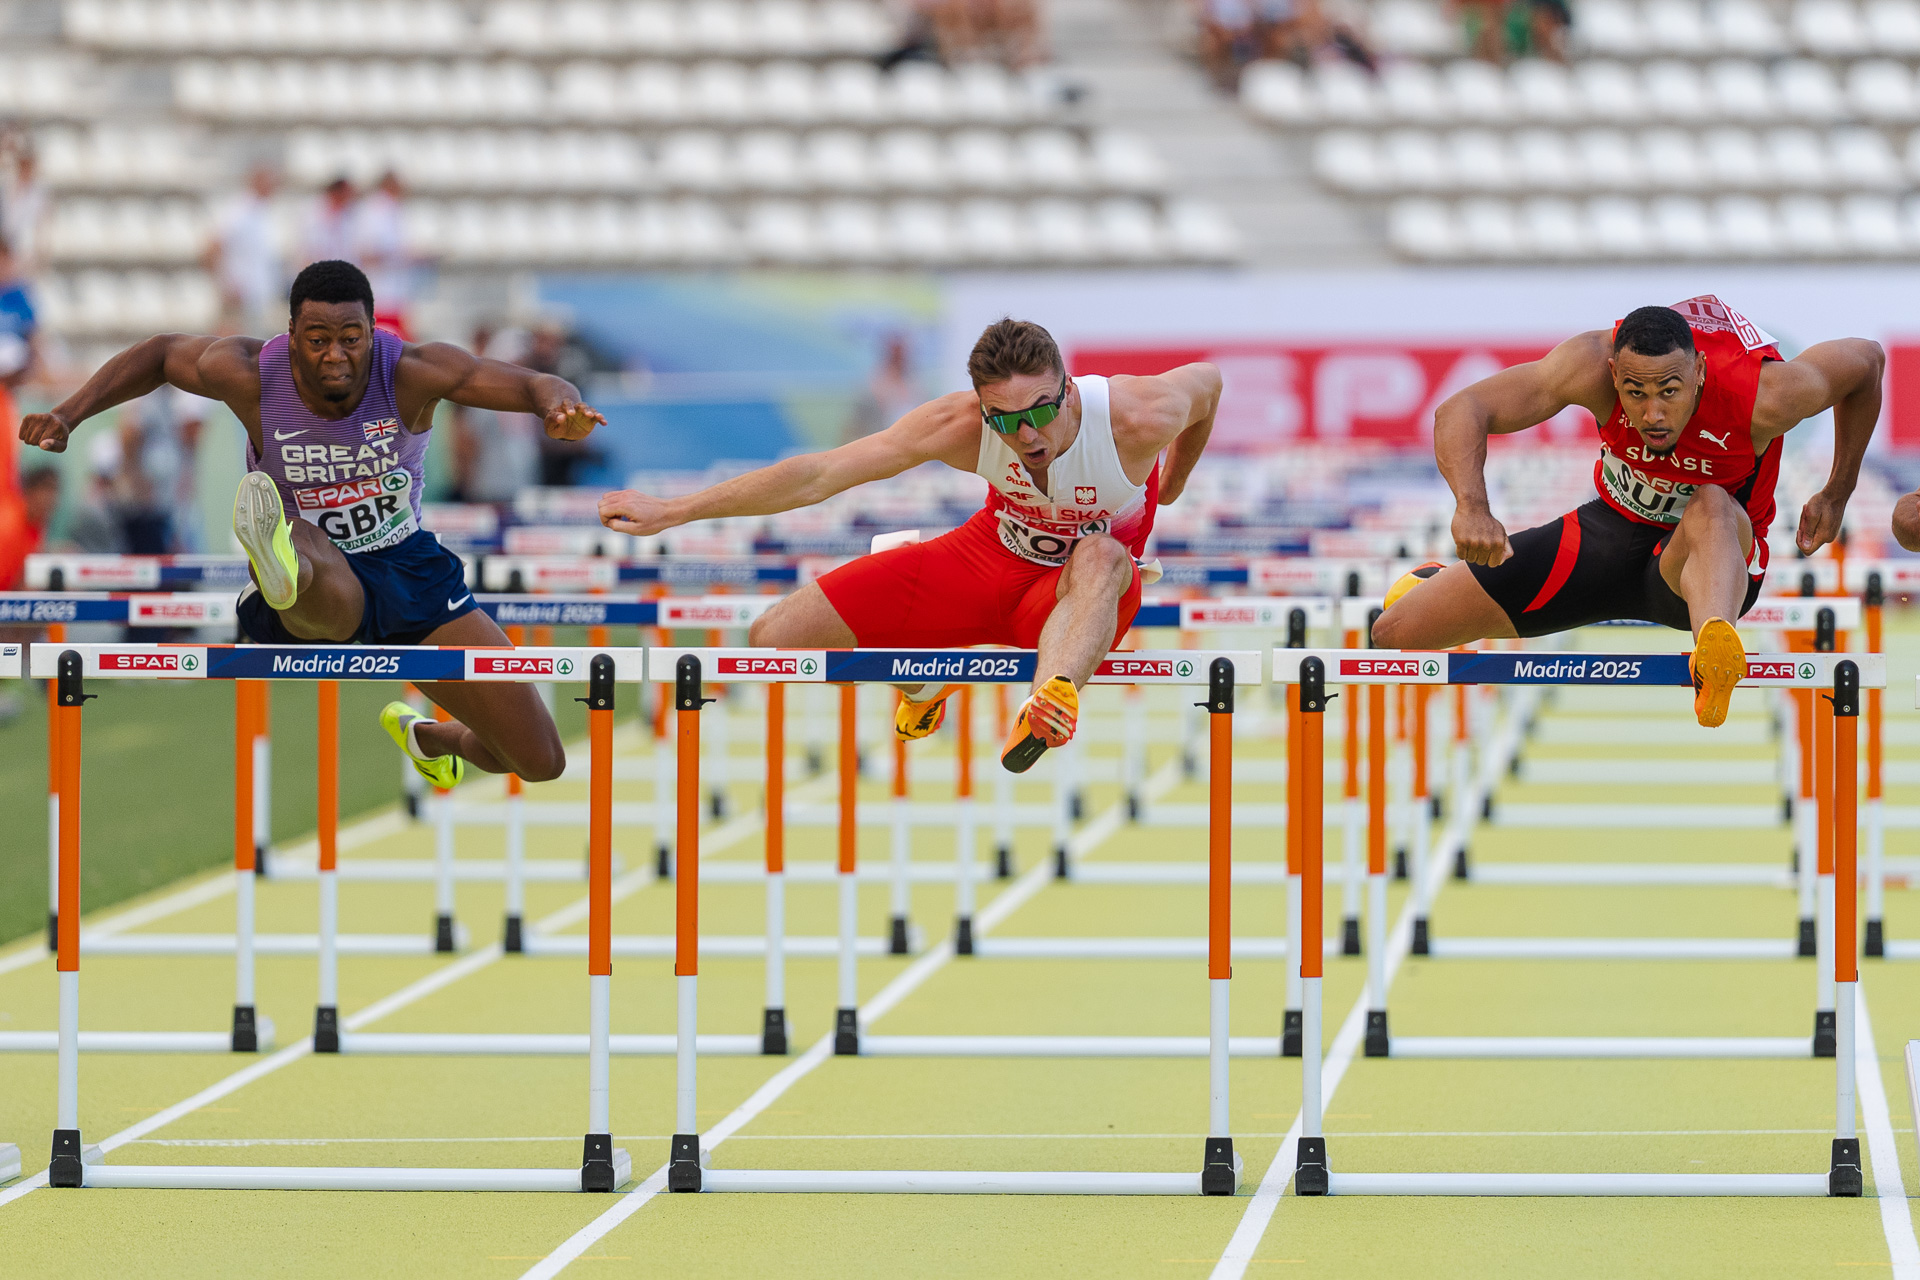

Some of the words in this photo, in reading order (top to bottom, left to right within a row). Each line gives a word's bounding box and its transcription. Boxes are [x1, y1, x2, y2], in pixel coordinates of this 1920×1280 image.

[1730, 309, 1759, 345] SP
[280, 436, 394, 463] GREAT
[284, 451, 399, 483] BRITAIN
[1617, 463, 1678, 513] SUI
[1633, 469, 1673, 492] AR
[299, 480, 380, 508] SPAR
[318, 494, 400, 540] GBR
[383, 523, 410, 547] 2025
[117, 656, 177, 668] SPAR
[272, 654, 345, 673] Madrid
[348, 656, 401, 673] 2025
[492, 659, 552, 671] SPAR
[736, 660, 796, 672] SPAR
[891, 657, 964, 676] Madrid
[968, 659, 1020, 676] 2025
[1111, 662, 1171, 674] SPAR
[1358, 661, 1418, 674] SPAR
[1514, 660, 1587, 678] Madrid
[1590, 661, 1642, 678] 2025
[1749, 664, 1794, 677] PAR
